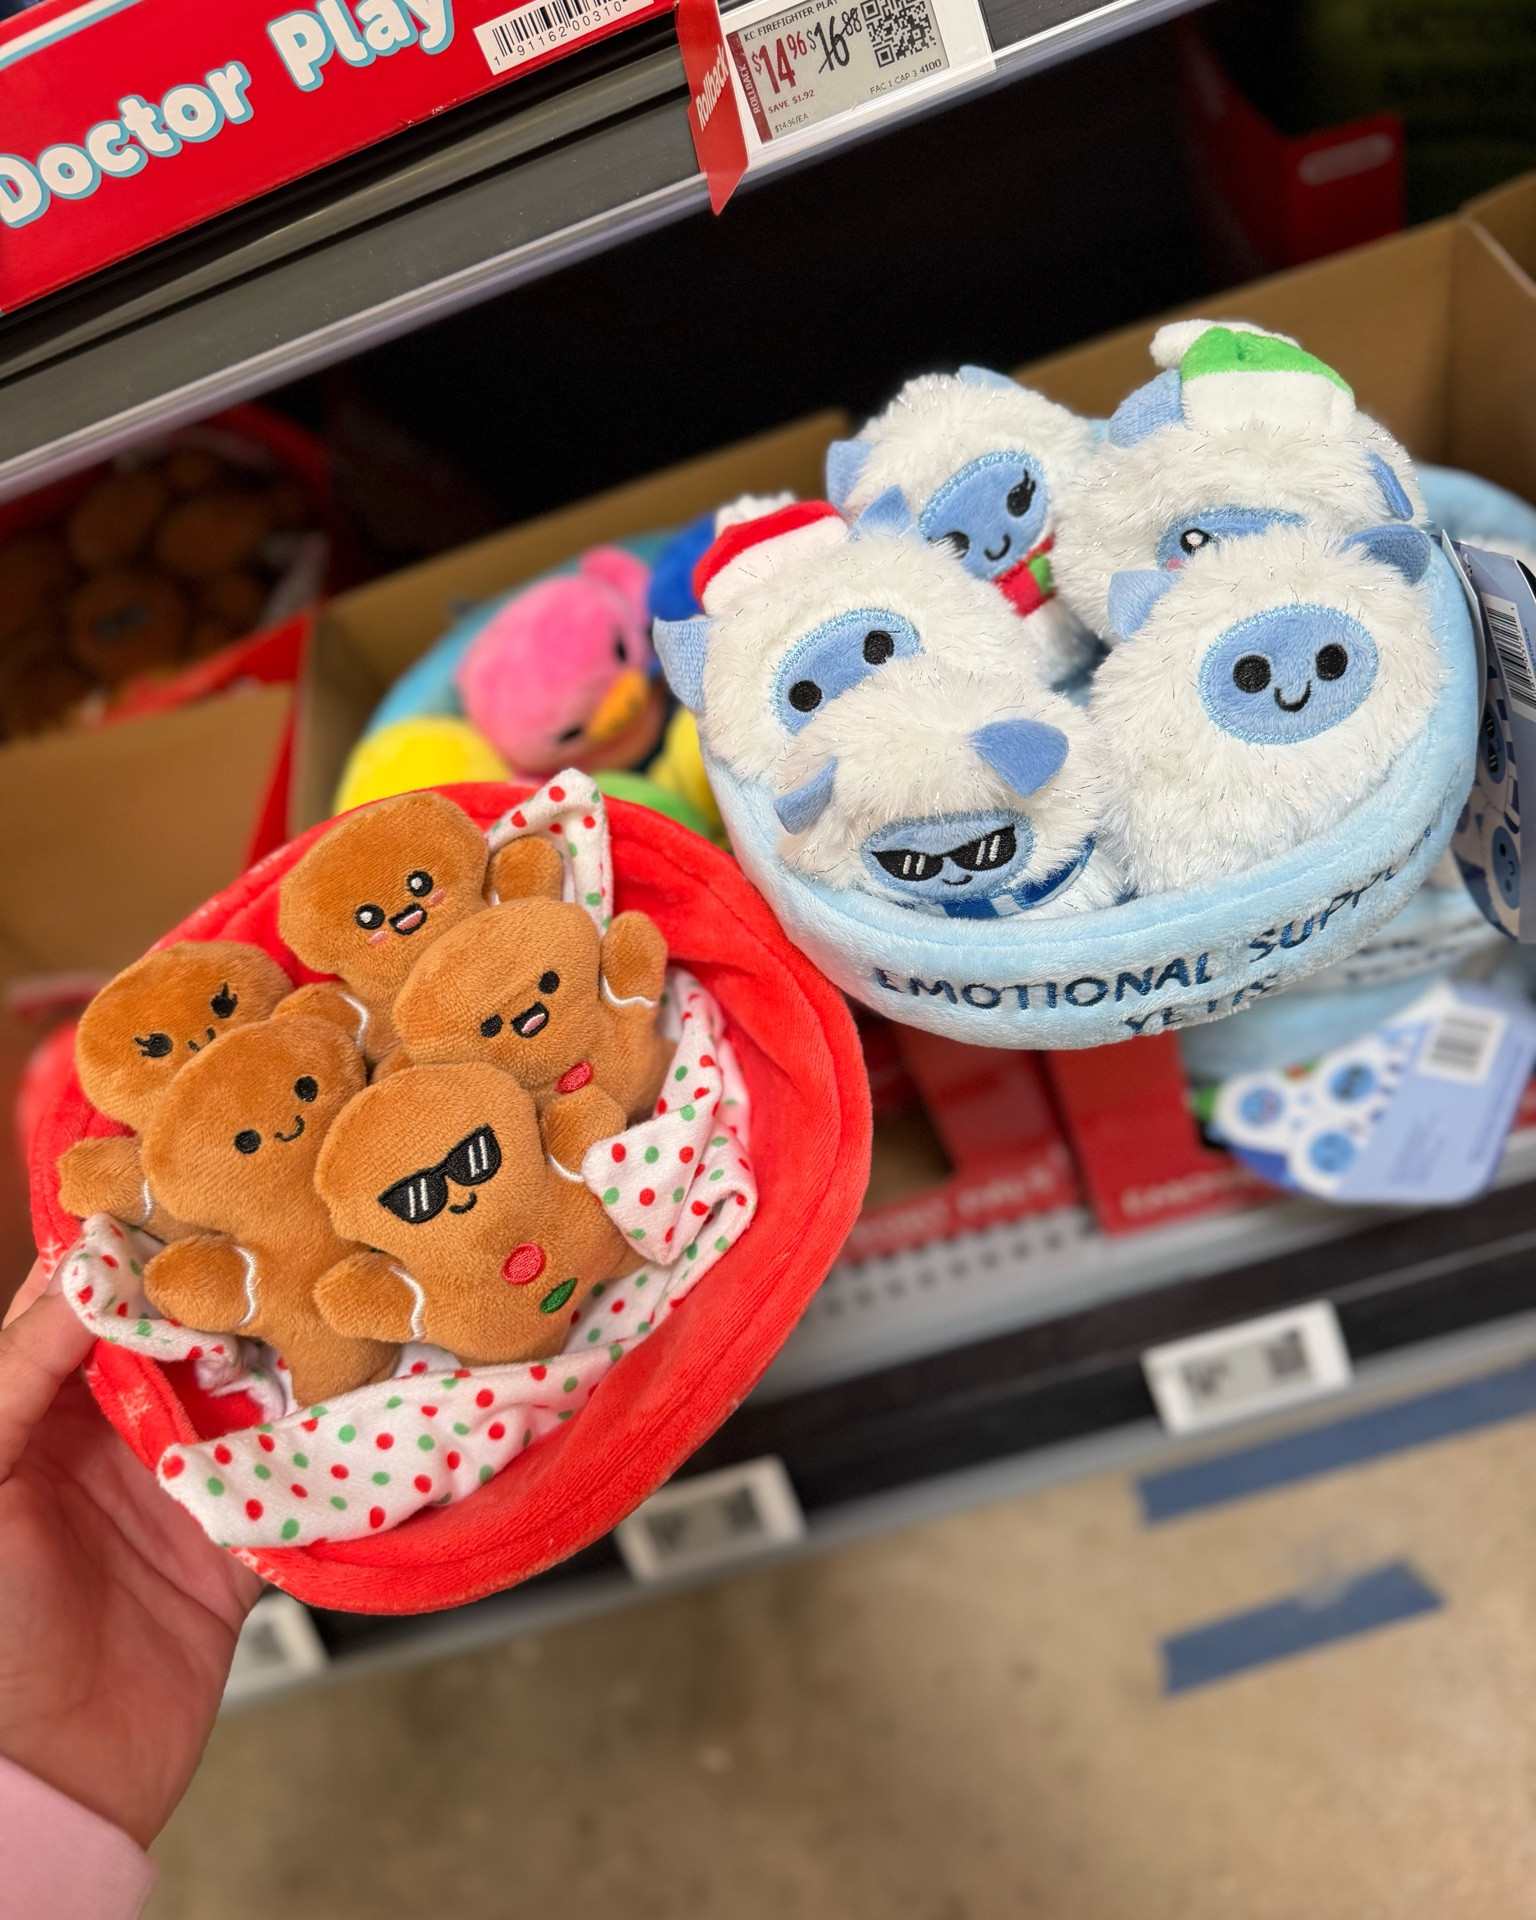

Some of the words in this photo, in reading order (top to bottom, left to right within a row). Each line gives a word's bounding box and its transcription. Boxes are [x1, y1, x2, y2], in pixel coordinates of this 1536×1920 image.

[494, 56, 502, 66] 1
[516, 26, 568, 56] 91162
[572, 1, 622, 31] 00310
[743, 31, 757, 42] KC
[757, 6, 815, 37] FIREFIGHTER
[695, 43, 729, 133] Rollback
[738, 63, 762, 115] ROLLBACK
[768, 99, 790, 113] SAVE
[791, 89, 816, 104] $1.92
[869, 82, 887, 95] FAC
[894, 72, 911, 84] CAP
[912, 69, 918, 77] 3
[919, 58, 942, 74] 4100
[0, 62, 252, 227] Doctor
[267, 0, 455, 92] Play
[874, 952, 1213, 1009] EMOTIONAL
